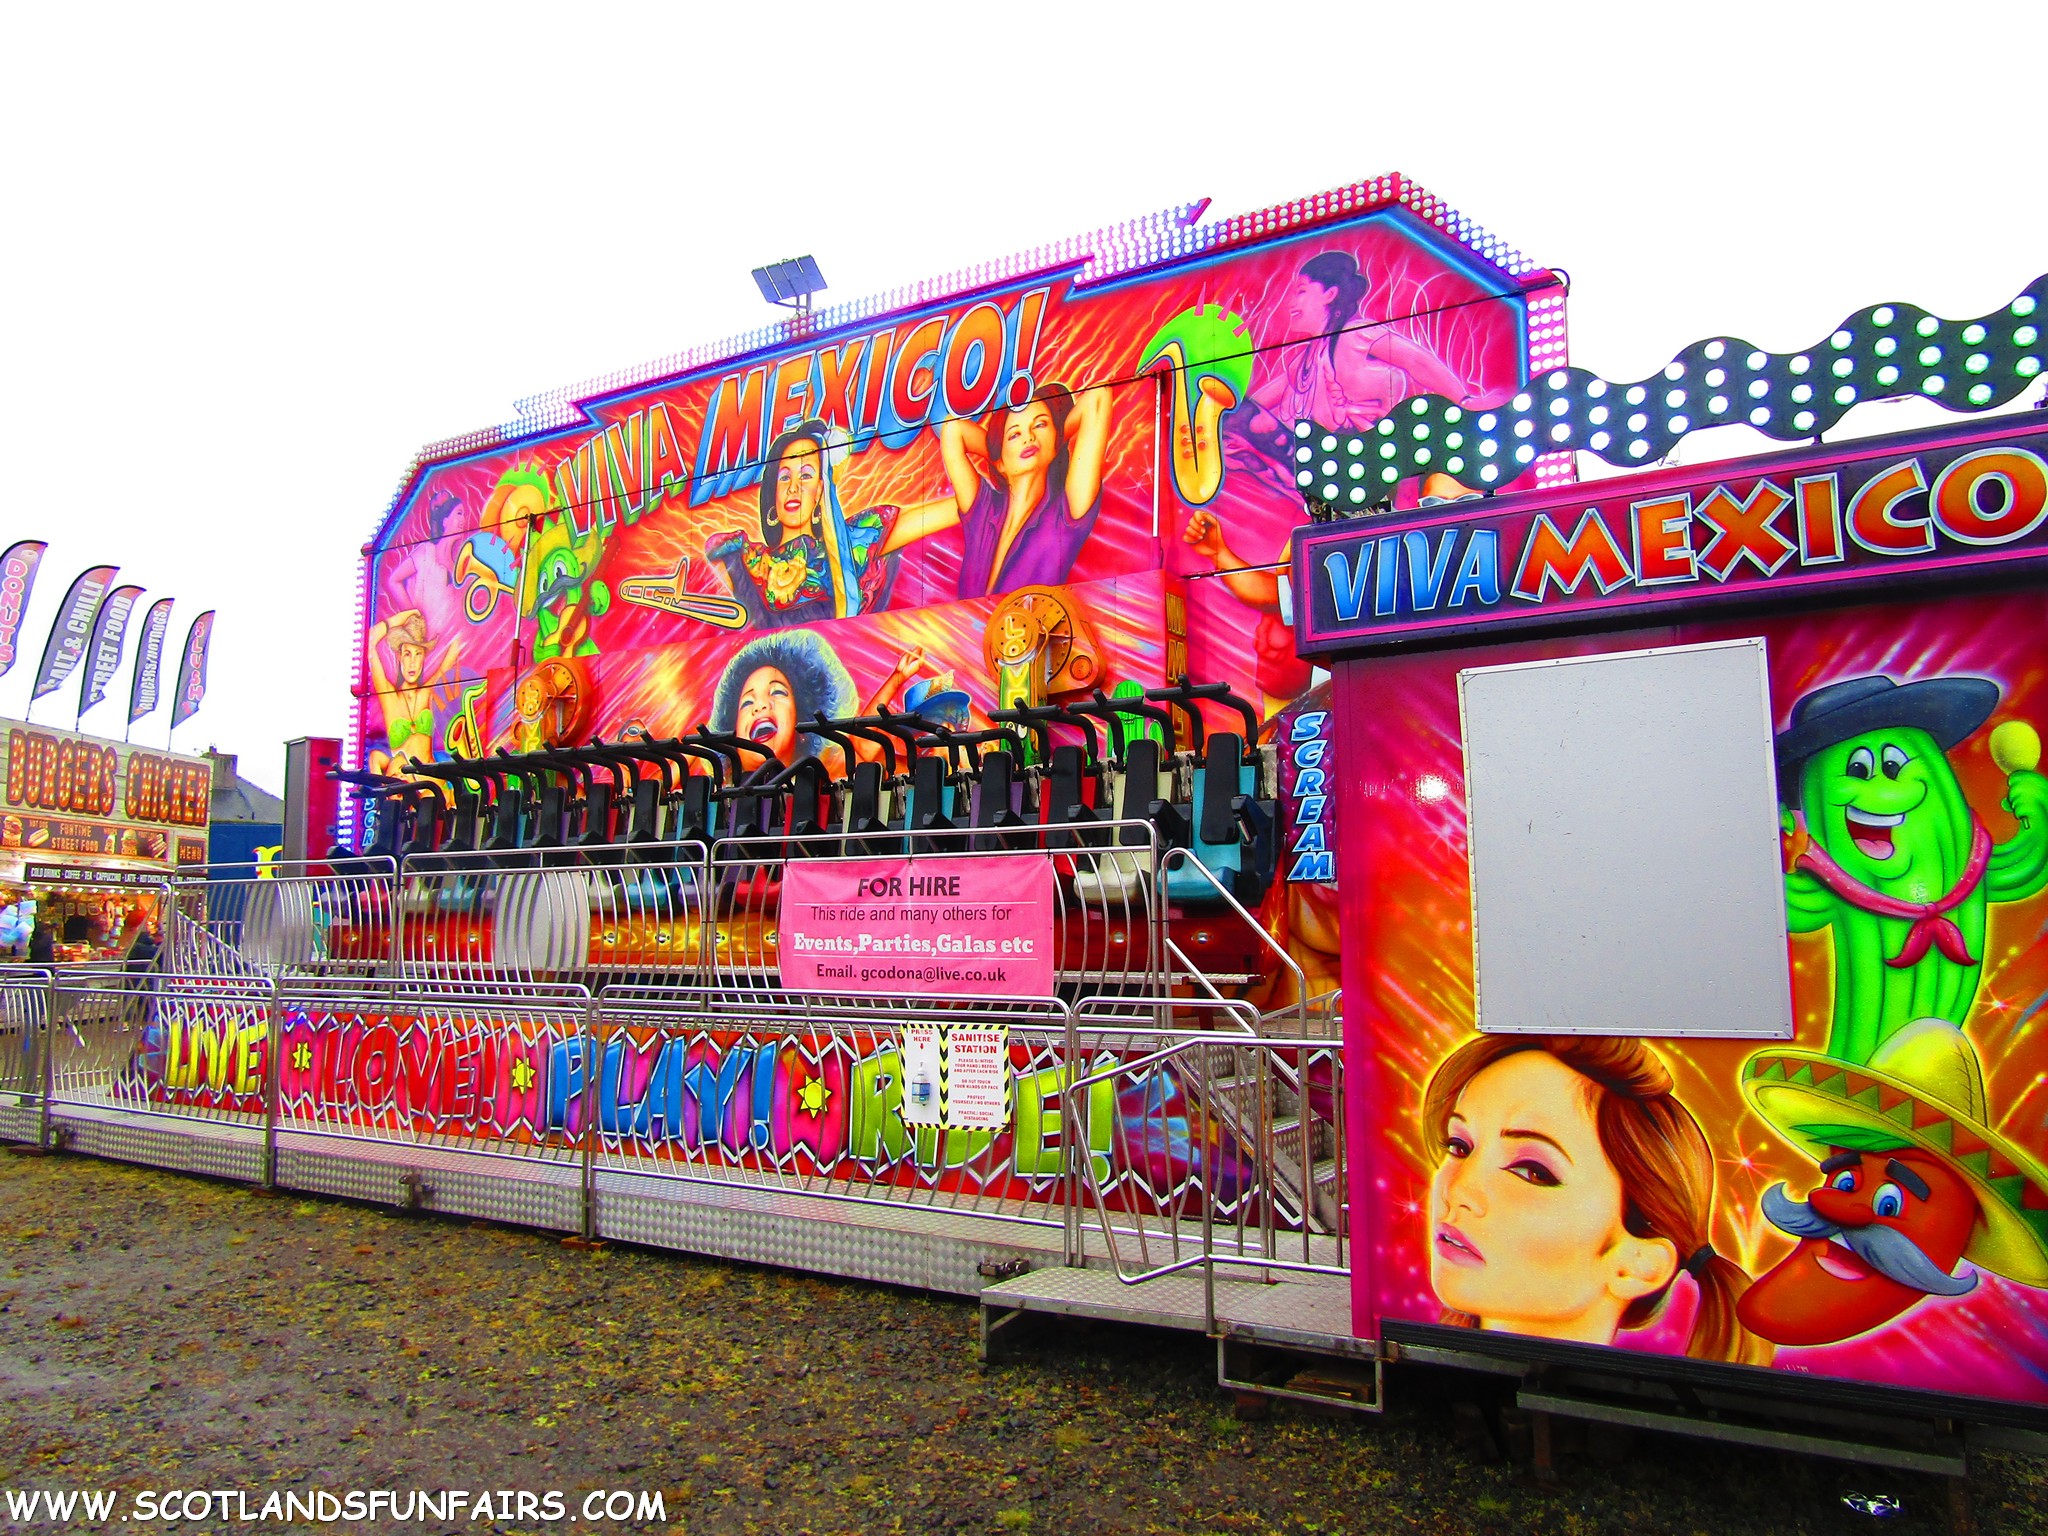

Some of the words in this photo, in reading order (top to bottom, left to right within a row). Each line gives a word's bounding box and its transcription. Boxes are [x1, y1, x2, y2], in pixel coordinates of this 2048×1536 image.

[556, 402, 689, 541] VIVA
[694, 286, 1051, 500] MEXICO!
[1323, 529, 1501, 622] VIVA
[1510, 446, 2048, 602] MEXICO
[0, 558, 28, 663] DONUTS
[67, 579, 105, 634] CHILLI
[103, 595, 133, 642] FOOD
[188, 621, 205, 701] SLUSH
[89, 641, 119, 703] STREET
[7, 729, 117, 817] BURGERS
[125, 751, 211, 827] CHICKEN
[1286, 711, 1333, 881] SCREAM
[60, 823, 92, 838] FUNTIME
[51, 837, 80, 851] STREET
[80, 839, 99, 853] FOOD
[179, 845, 203, 861] MENU
[64, 869, 81, 880] COFFEE
[858, 877, 902, 897] FOR
[909, 876, 961, 896] HIRE
[811, 906, 836, 921] This
[840, 906, 865, 921] ride
[870, 906, 895, 921] and
[901, 908, 938, 925] many
[943, 906, 988, 921] others
[992, 905, 1012, 920] for
[1001, 936, 1034, 953] etc
[816, 964, 857, 978] Email.
[861, 965, 1007, 984] gcodona@live.co.uk
[910, 1028, 934, 1036] PRSS
[913, 1035, 932, 1043] HERE
[951, 1033, 1001, 1043] SANITISE
[954, 1044, 997, 1054] STATION
[320, 1023, 503, 1124] LOVE!
[546, 1035, 777, 1150] PLAY!
